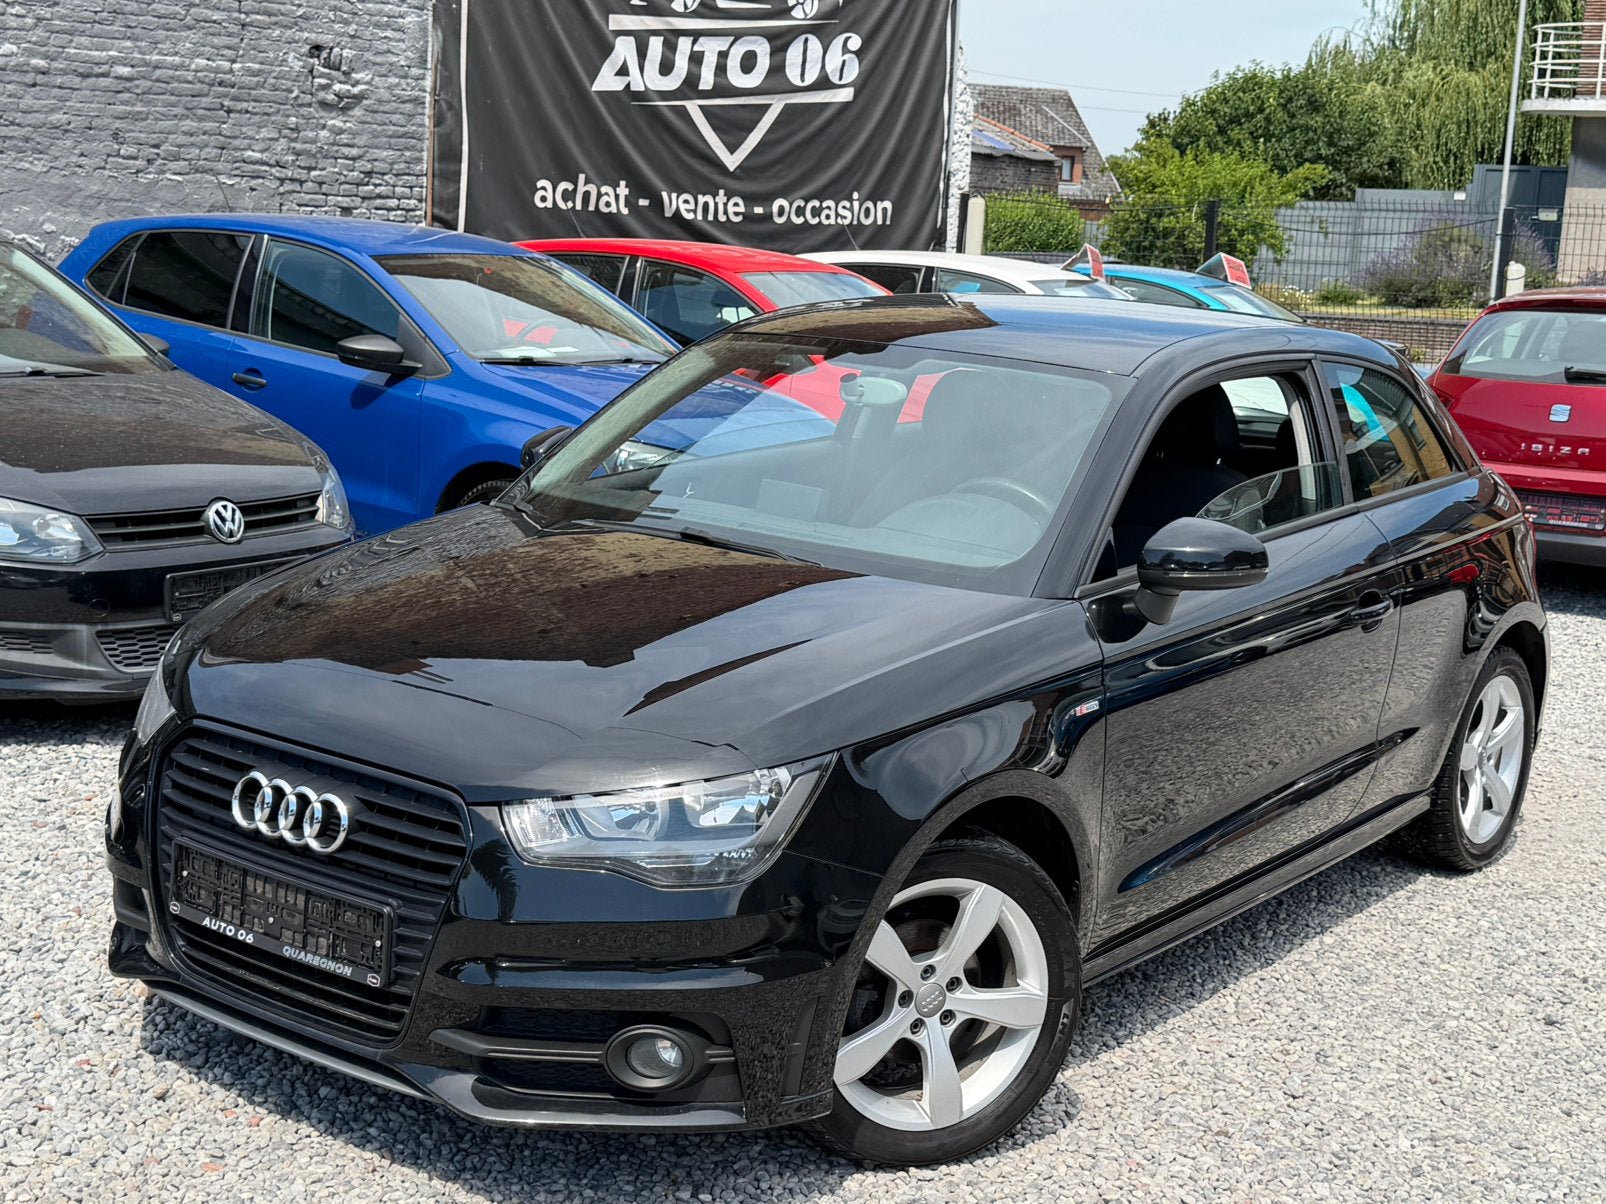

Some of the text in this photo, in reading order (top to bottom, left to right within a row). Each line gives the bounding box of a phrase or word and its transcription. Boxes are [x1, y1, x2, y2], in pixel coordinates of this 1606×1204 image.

[591, 32, 863, 92] AUTO 06
[533, 173, 630, 216] achat
[661, 188, 746, 223] vente
[771, 190, 893, 226] occasion
[201, 916, 255, 944] AUTO 06
